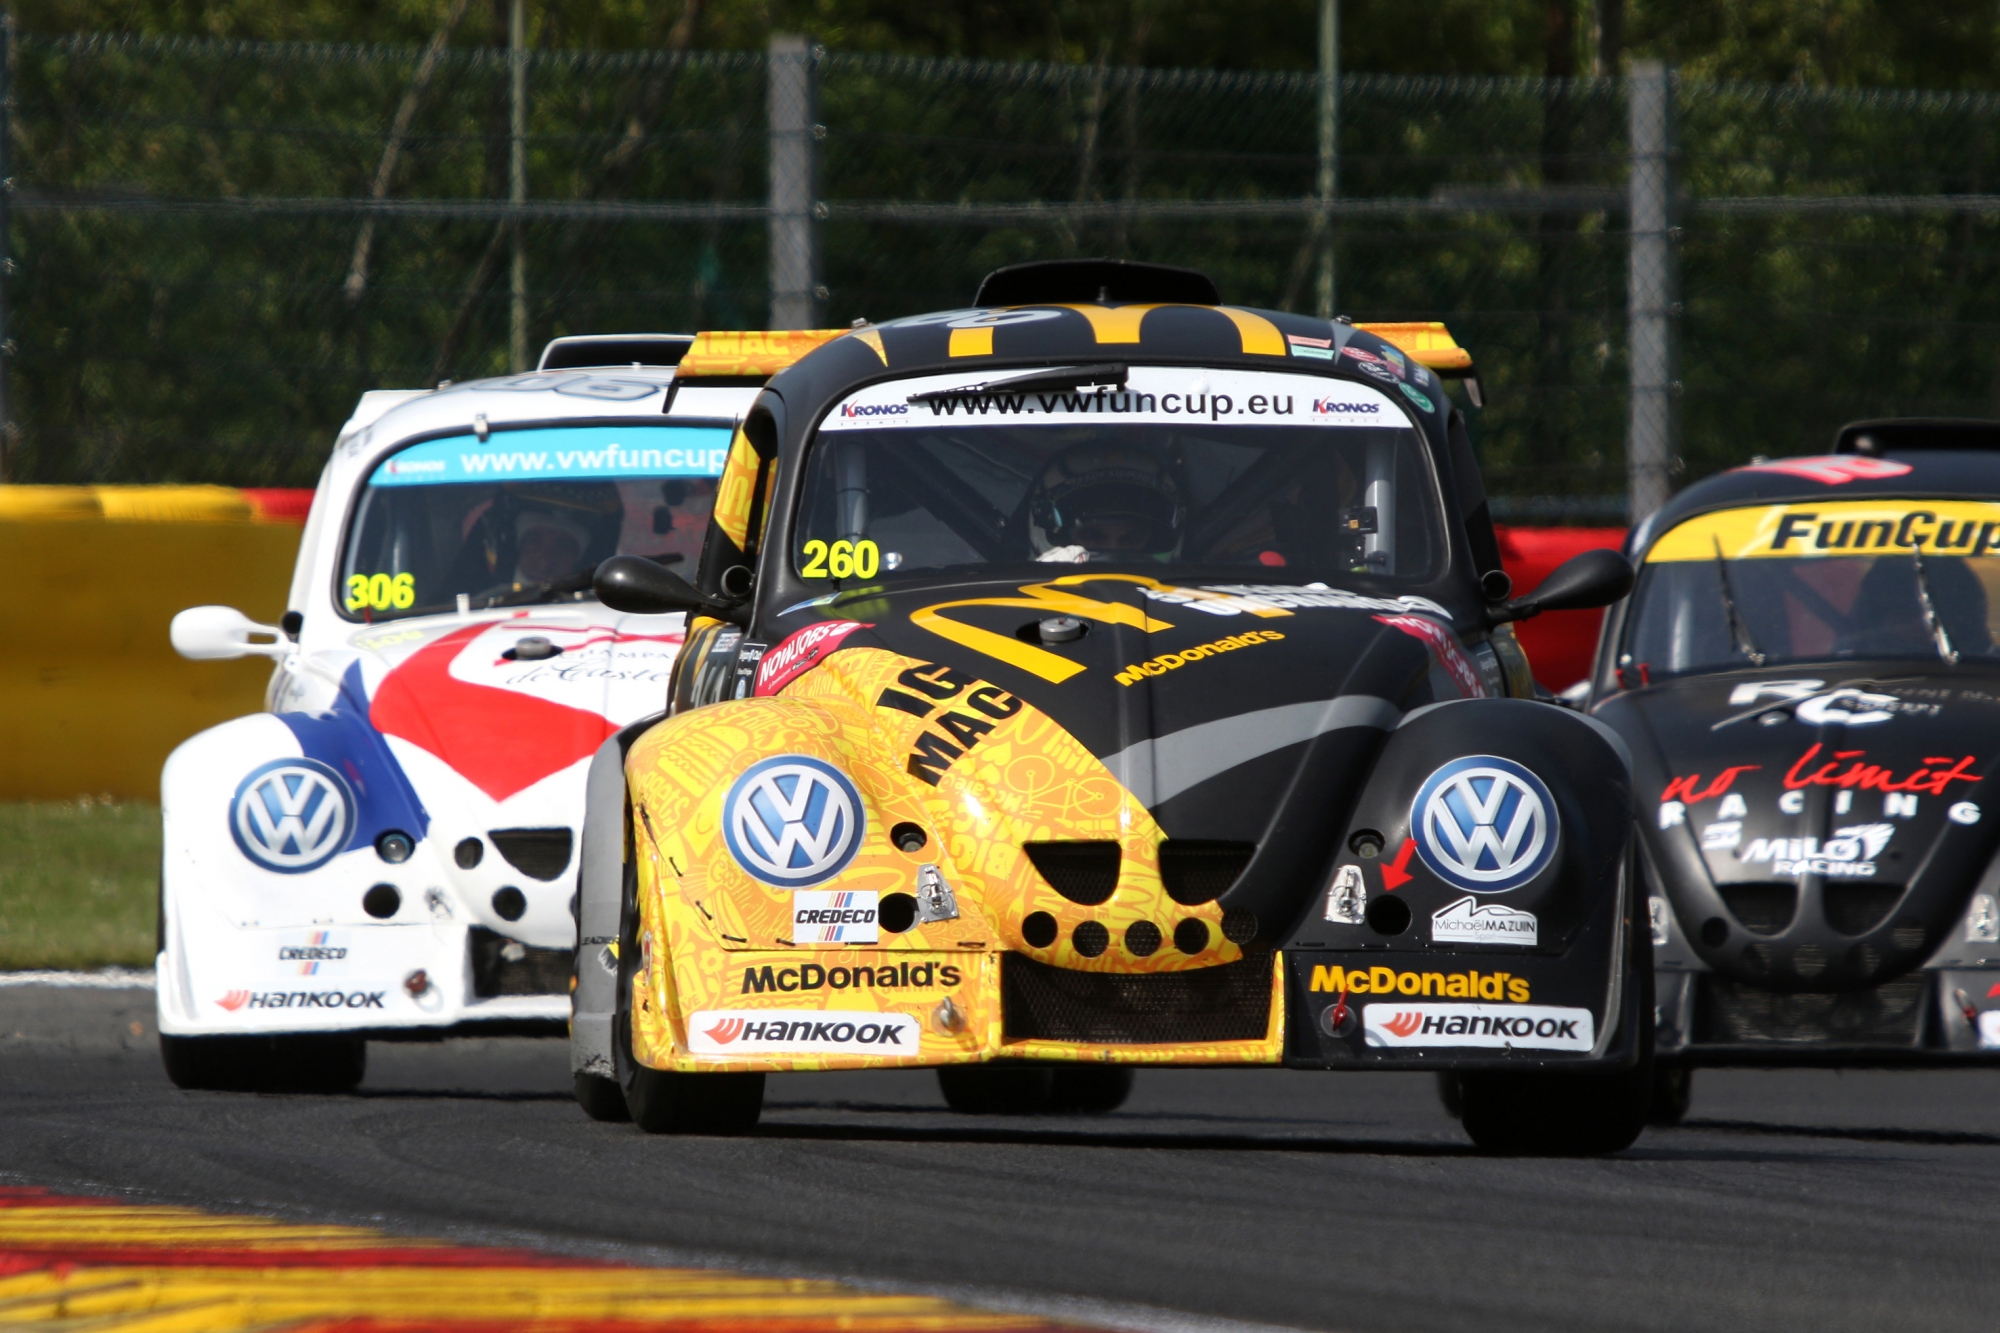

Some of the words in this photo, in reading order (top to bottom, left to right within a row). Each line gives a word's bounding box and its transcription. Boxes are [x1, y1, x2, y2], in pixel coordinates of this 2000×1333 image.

[840, 399, 908, 417] KRONOS
[926, 386, 1293, 421] www.vwfuncup.eu
[1312, 396, 1380, 414] KRONOS
[1770, 511, 2000, 556] FunCup
[802, 539, 880, 579] 260
[346, 573, 415, 611] 306
[1114, 630, 1286, 687] McDonald's
[907, 687, 1023, 787] MAC
[1659, 789, 1982, 830] RACING
[795, 908, 877, 924] CREDECO
[741, 961, 961, 994] McDonald's
[1310, 964, 1531, 1003] McDonald's
